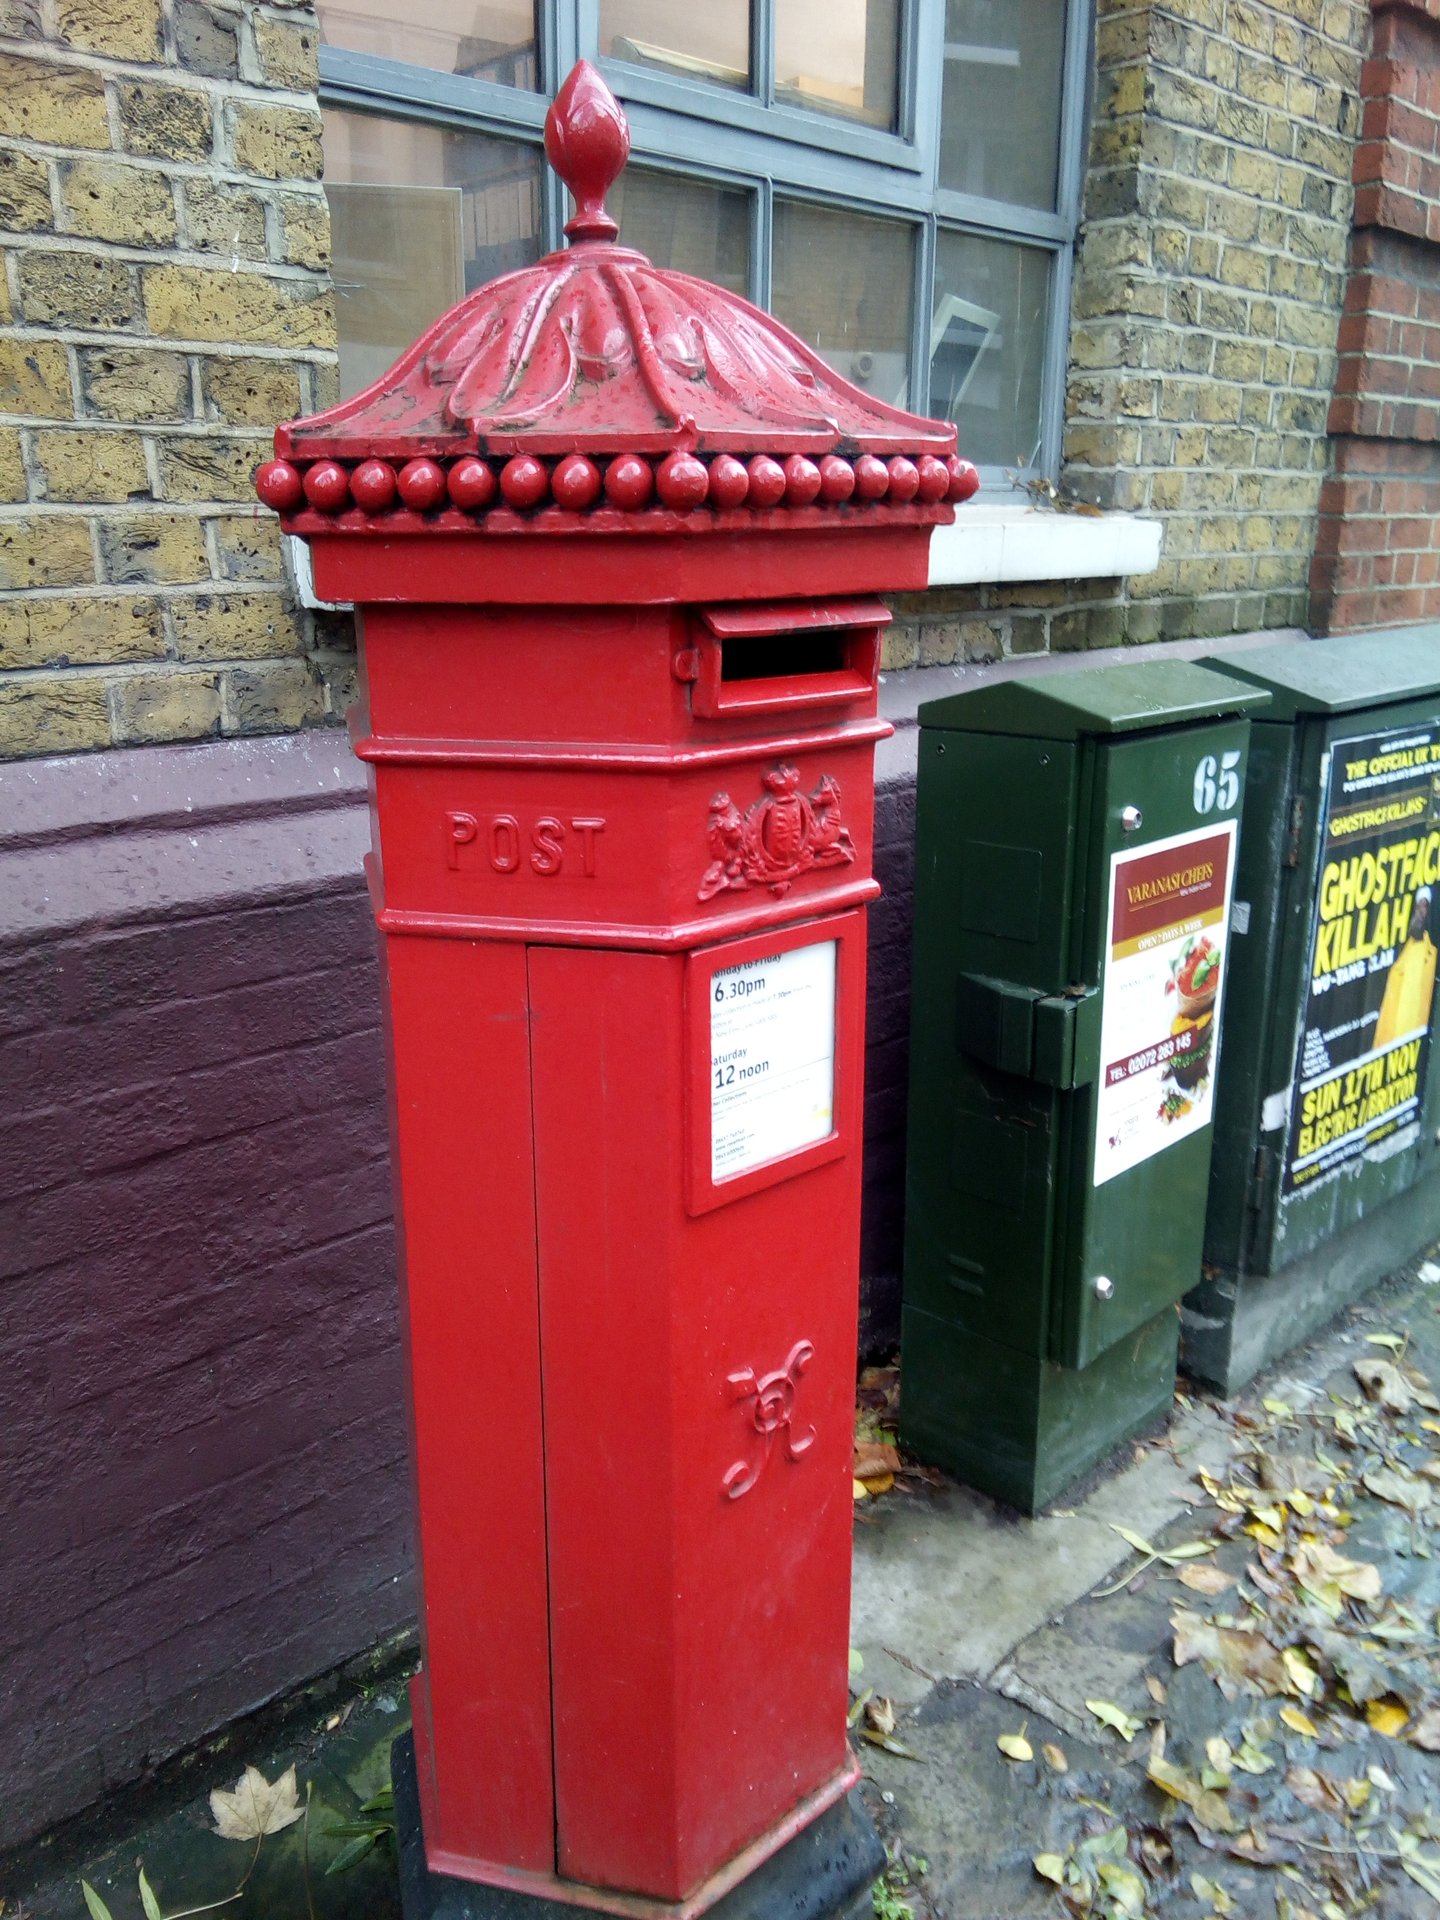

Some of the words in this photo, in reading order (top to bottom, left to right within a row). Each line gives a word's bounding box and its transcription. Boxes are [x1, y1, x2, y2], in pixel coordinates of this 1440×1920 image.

[1193, 750, 1241, 815] 65
[1345, 759, 1368, 781] THE
[1369, 749, 1414, 775] OFFICIAL
[1415, 747, 1430, 765] UK
[445, 811, 607, 878] POST
[1127, 872, 1181, 905] VARANASI
[1181, 861, 1214, 887] CHEFS
[1320, 829, 1440, 922] GHOSTFAC
[1137, 935, 1159, 951] OPEN
[1184, 919, 1204, 934] WEEK
[1312, 893, 1413, 978] KILLAH
[713, 962, 742, 979] onday
[714, 977, 766, 1003] 6.30pm
[1312, 959, 1366, 996] WU-TANG
[1367, 948, 1395, 974] CLAN
[713, 1047, 748, 1067] aturday
[715, 1064, 736, 1090] 12
[738, 1060, 770, 1081] noon
[1301, 1078, 1342, 1126] SUN
[1343, 1056, 1385, 1106] 17TH
[1385, 1038, 1422, 1082] NOV
[1297, 1103, 1358, 1158] ELECTRIC
[1368, 1071, 1418, 1121] BRIXTON
